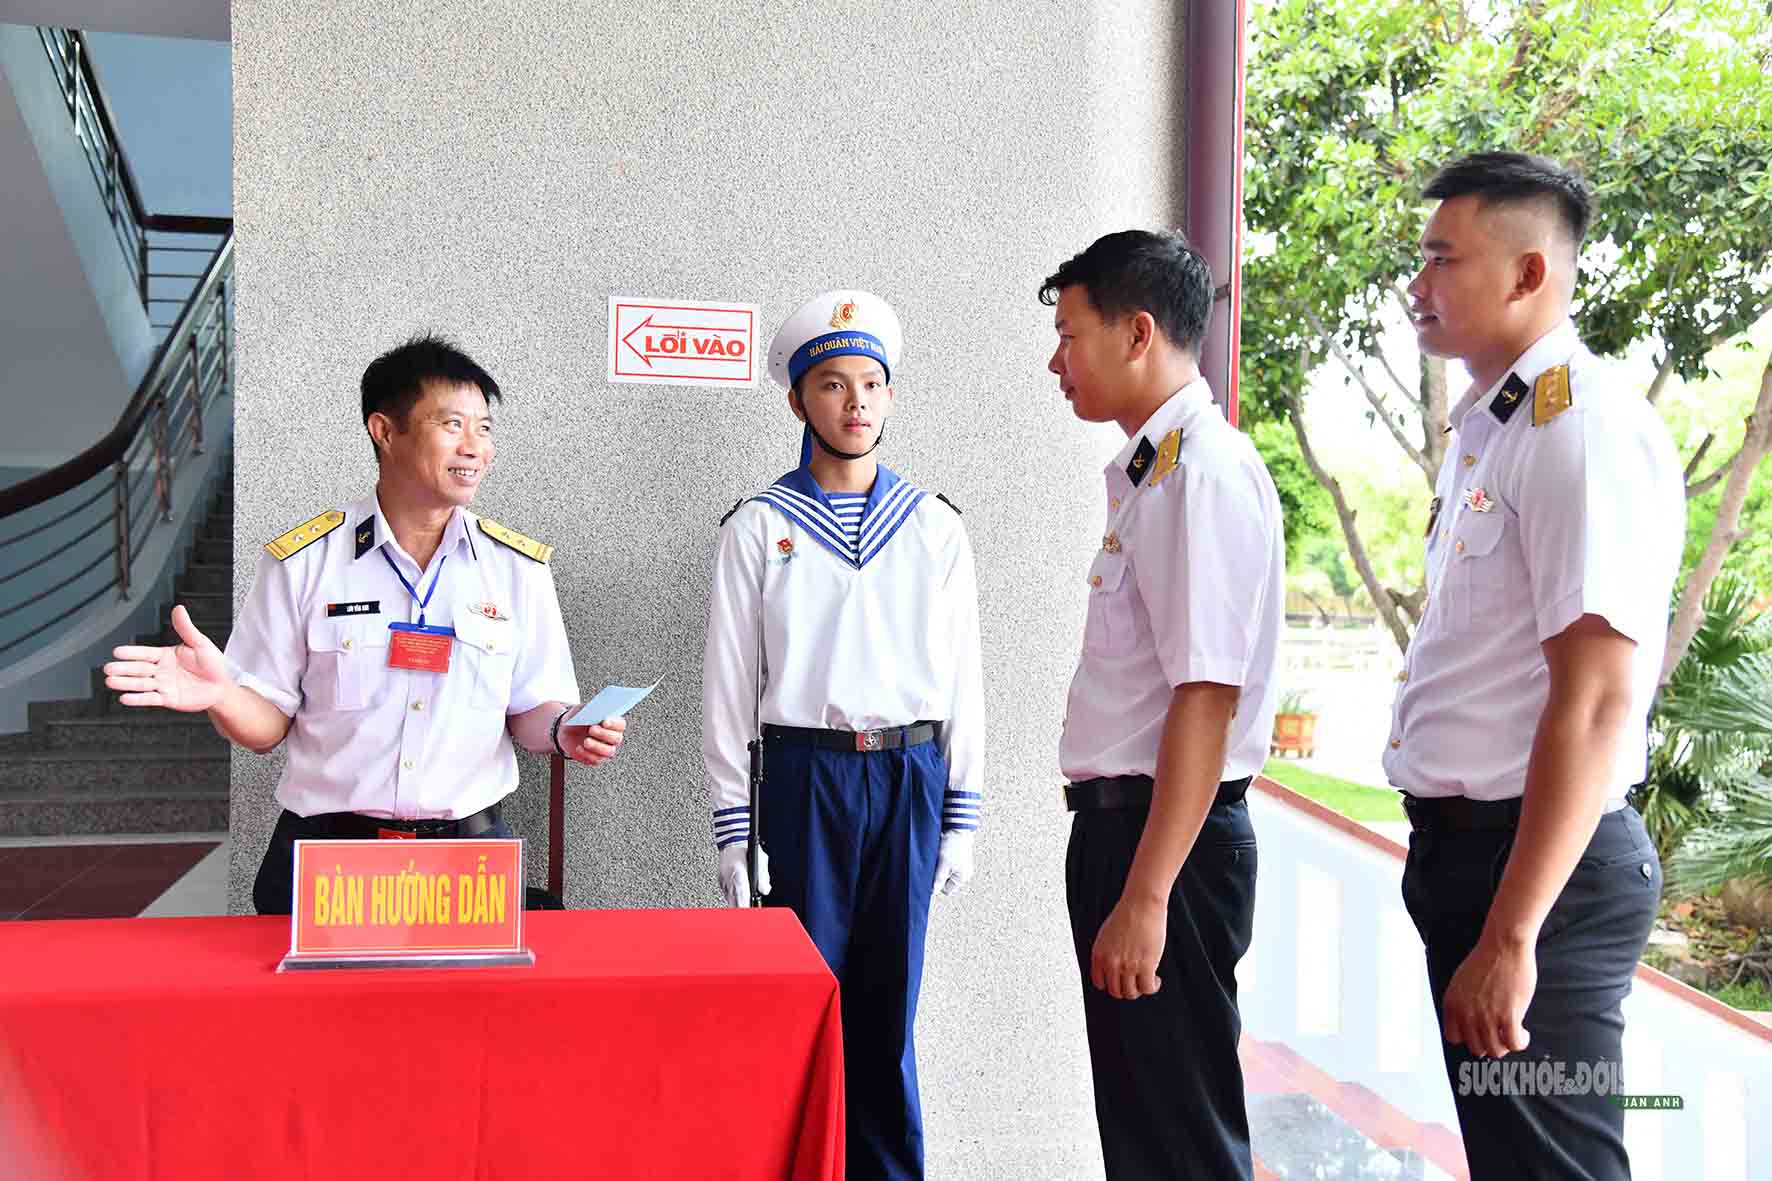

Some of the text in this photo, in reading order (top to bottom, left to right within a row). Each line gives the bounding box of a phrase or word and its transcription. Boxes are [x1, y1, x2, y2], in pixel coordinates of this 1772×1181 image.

[692, 334, 746, 356] VÀO
[824, 337, 849, 351] QUÂN
[314, 855, 506, 926] BÀN HƯỚNG DẪN
